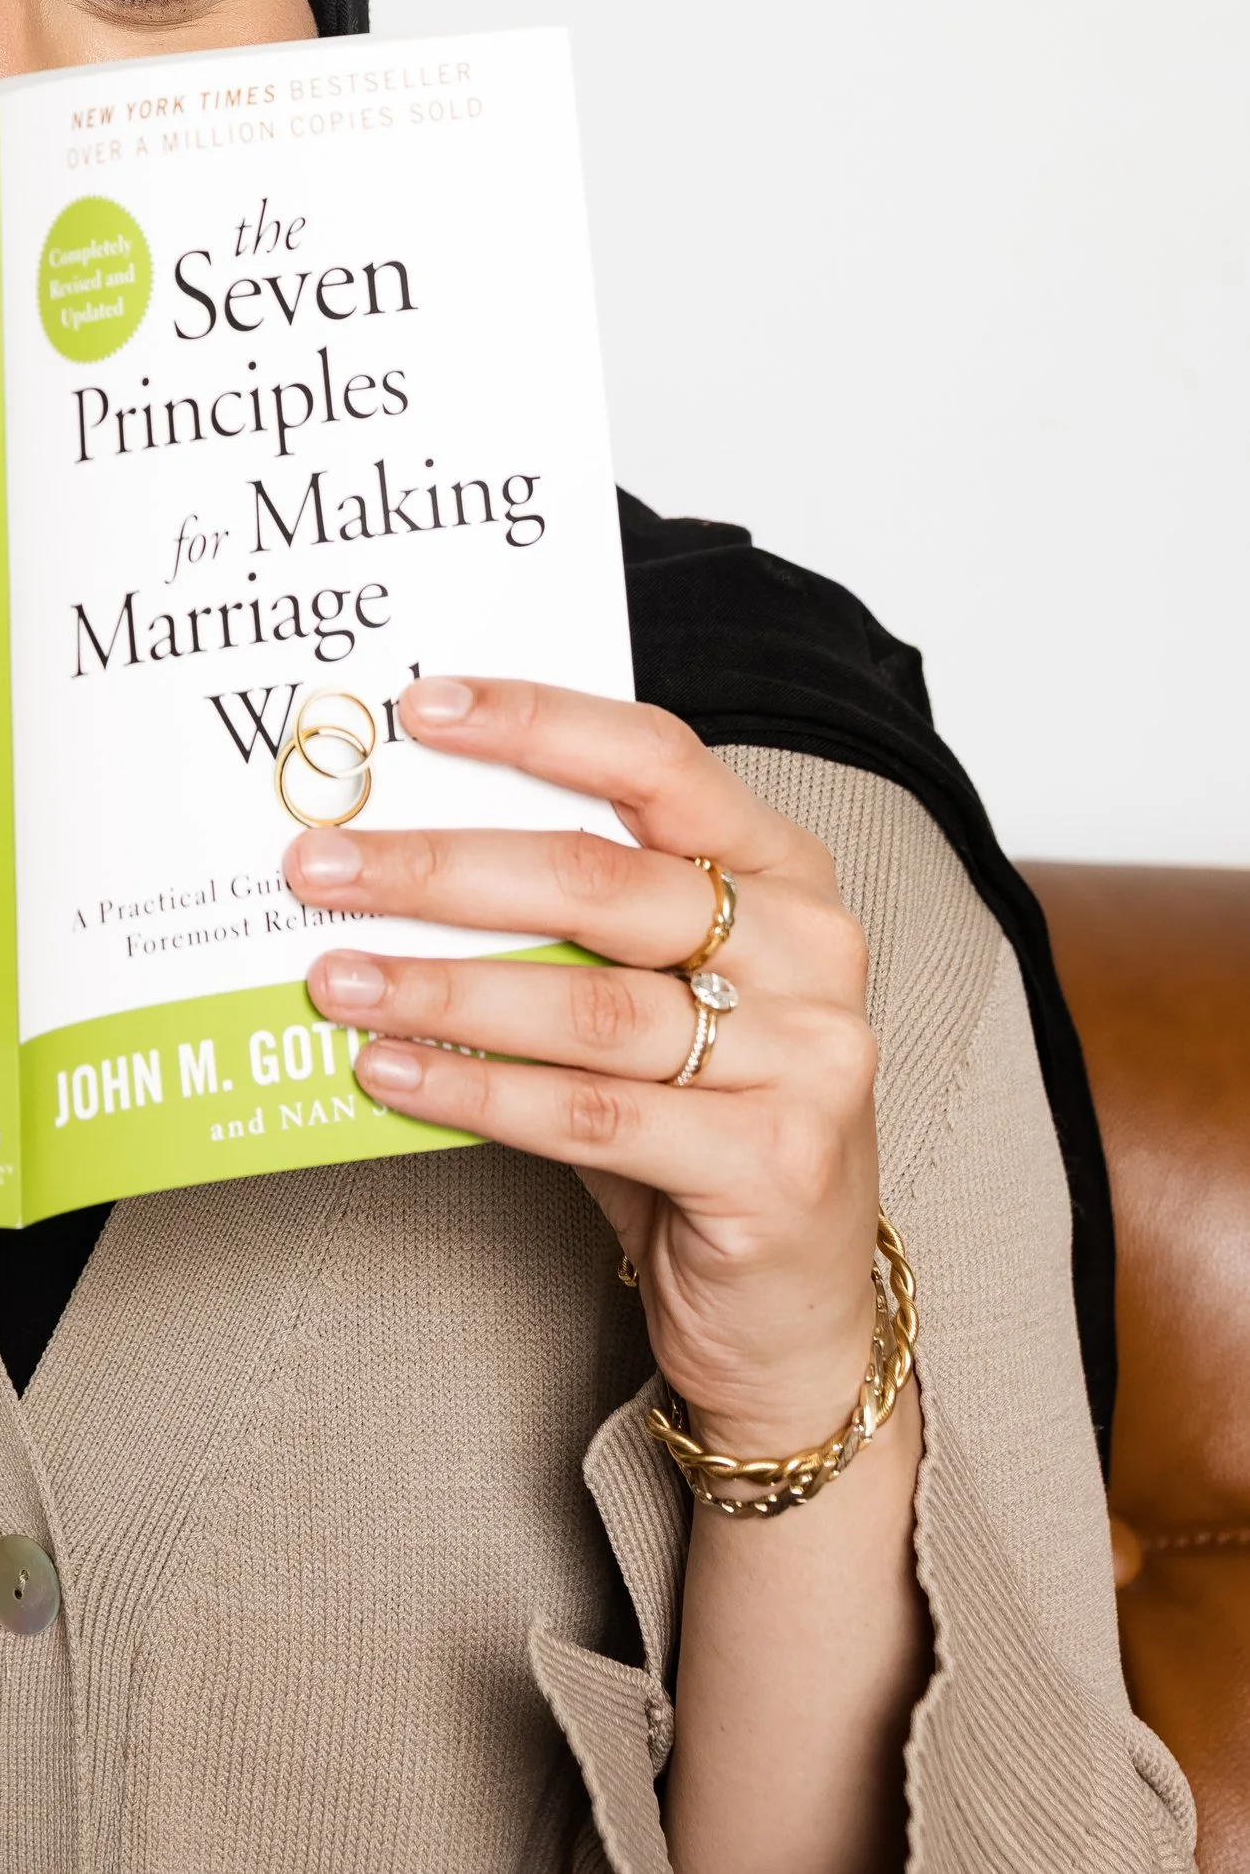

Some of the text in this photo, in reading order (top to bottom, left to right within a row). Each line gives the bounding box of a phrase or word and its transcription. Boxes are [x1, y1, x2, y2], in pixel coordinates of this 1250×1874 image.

[70, 61, 472, 131] NEW YORK TIMES BESTSELLER
[67, 97, 484, 170] OVER A MILLION COPIES SOLD
[48, 233, 133, 268] Completely
[234, 196, 307, 258] the
[49, 262, 136, 300] Revised and
[60, 295, 125, 330] Updated
[172, 249, 419, 341] Seven
[71, 344, 410, 464] Principles
[164, 458, 547, 585] for Making
[70, 572, 392, 679] Marriage
[71, 869, 293, 932] A Practical Gui
[125, 917, 251, 958] Foremost
[54, 1048, 164, 1129] JOHN
[178, 1038, 234, 1098] M.
[209, 1107, 266, 1141] and
[279, 1093, 357, 1131] NAN
